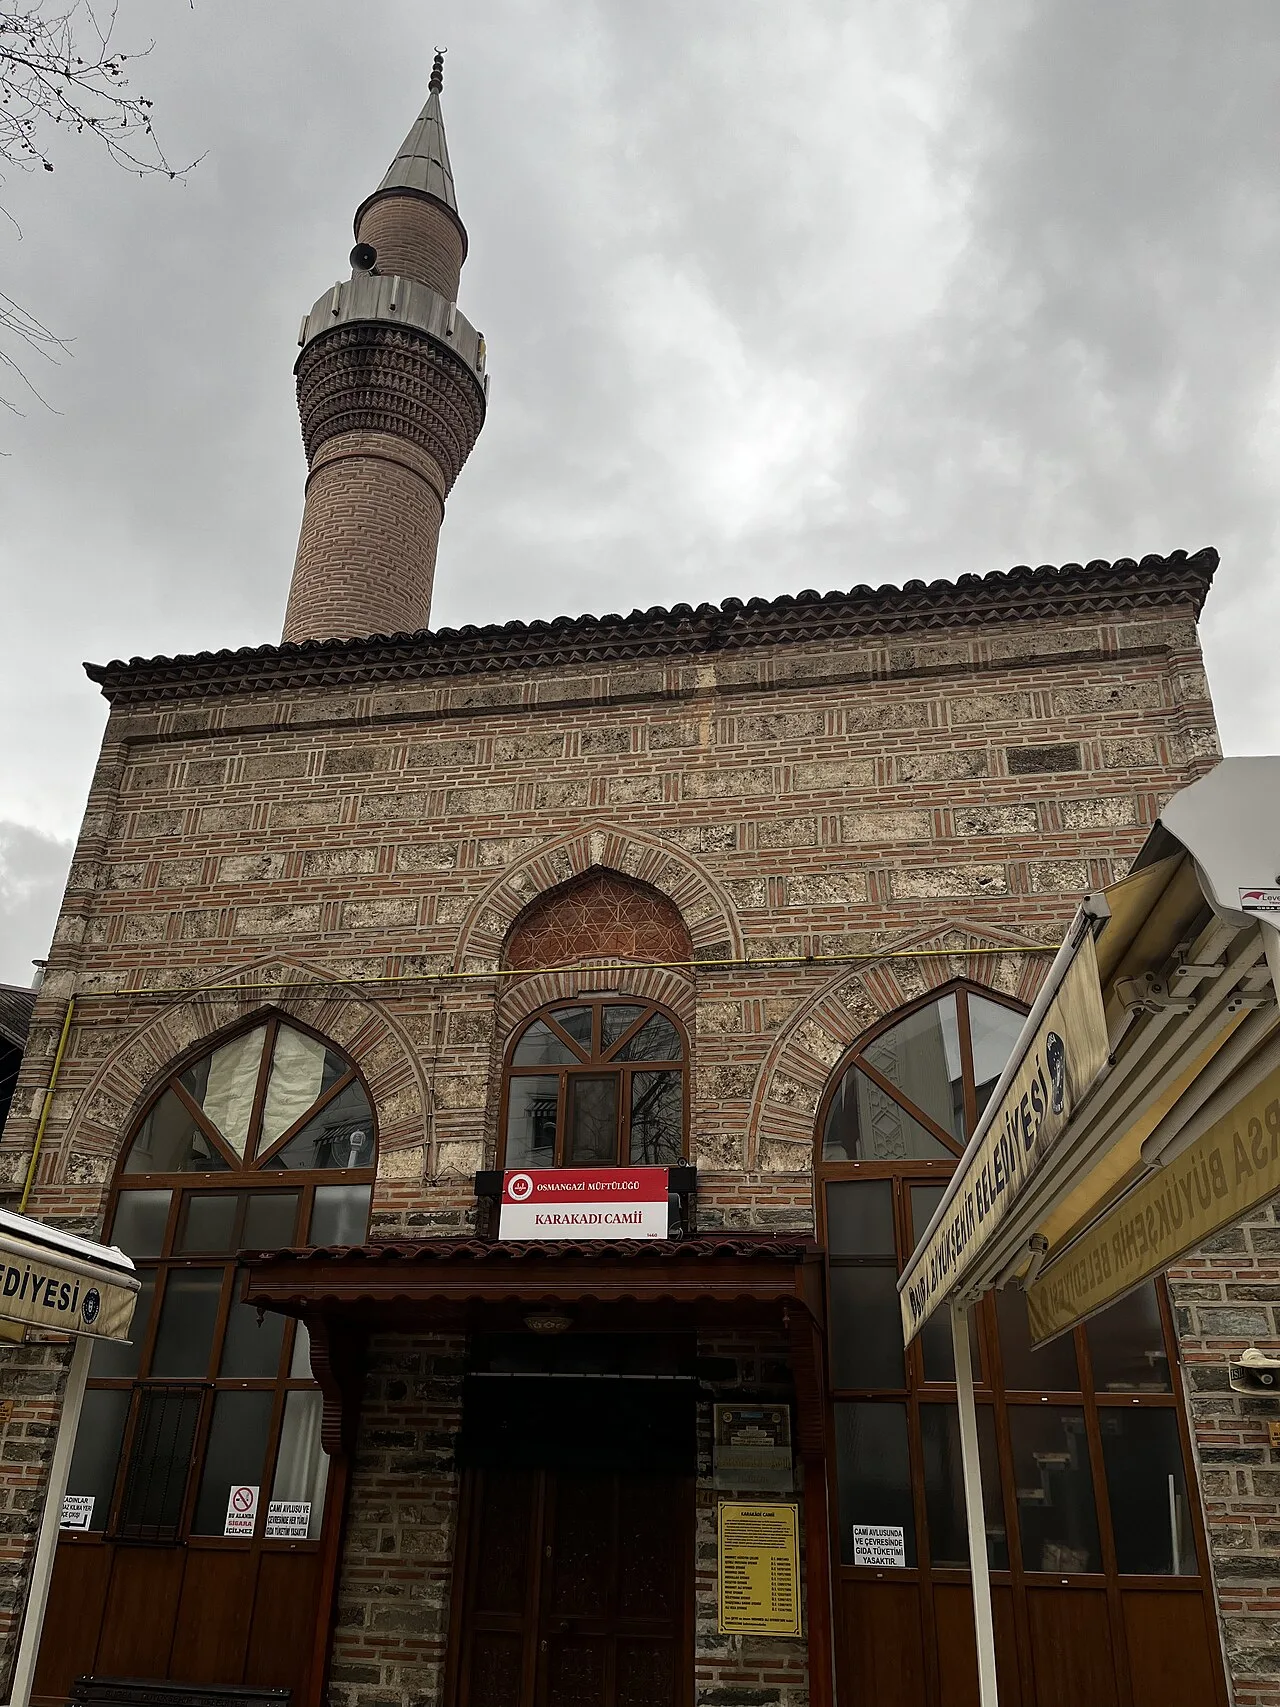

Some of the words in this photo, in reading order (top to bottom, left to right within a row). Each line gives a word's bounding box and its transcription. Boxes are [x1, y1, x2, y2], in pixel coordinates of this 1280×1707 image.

[976, 1053, 1049, 1225] BELEDİYESİ
[536, 1182, 585, 1191] OSMANGAZİ
[588, 1181, 640, 1190] MÜFTÜLÜĞÜ
[535, 1213, 602, 1225] KARAKADI
[604, 1211, 642, 1224] CAMİİ
[226, 1527, 253, 1535] İÇİLMEZ
[854, 1527, 868, 1536] CAMİ
[869, 1529, 903, 1537] AVLUSUNDA
[864, 1537, 903, 1547] ÇEVRESİNDE
[855, 1547, 872, 1555] GIDA
[873, 1546, 904, 1556] TÜKETİMİ
